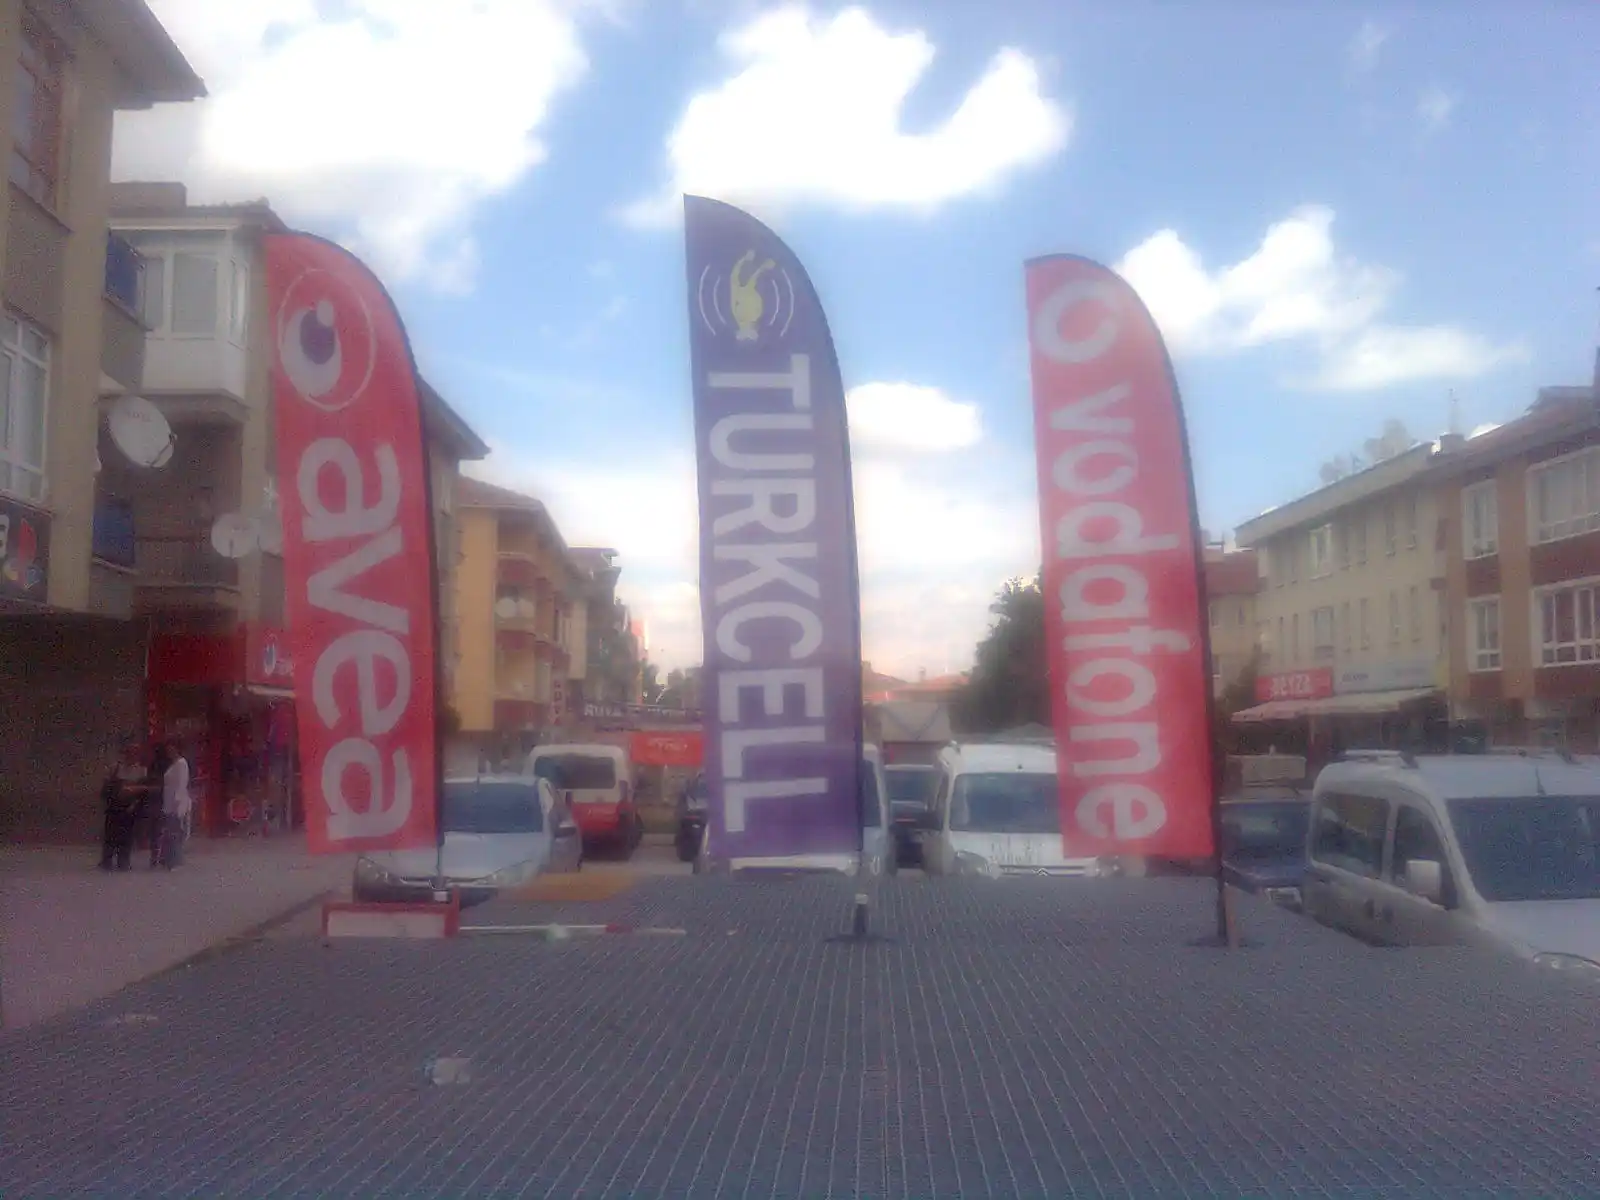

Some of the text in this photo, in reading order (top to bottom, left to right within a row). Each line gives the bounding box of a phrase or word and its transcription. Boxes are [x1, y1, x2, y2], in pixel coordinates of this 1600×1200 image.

[297, 437, 412, 841] avea
[708, 353, 828, 833] TURKCELL
[1050, 382, 1195, 840] vodafone
